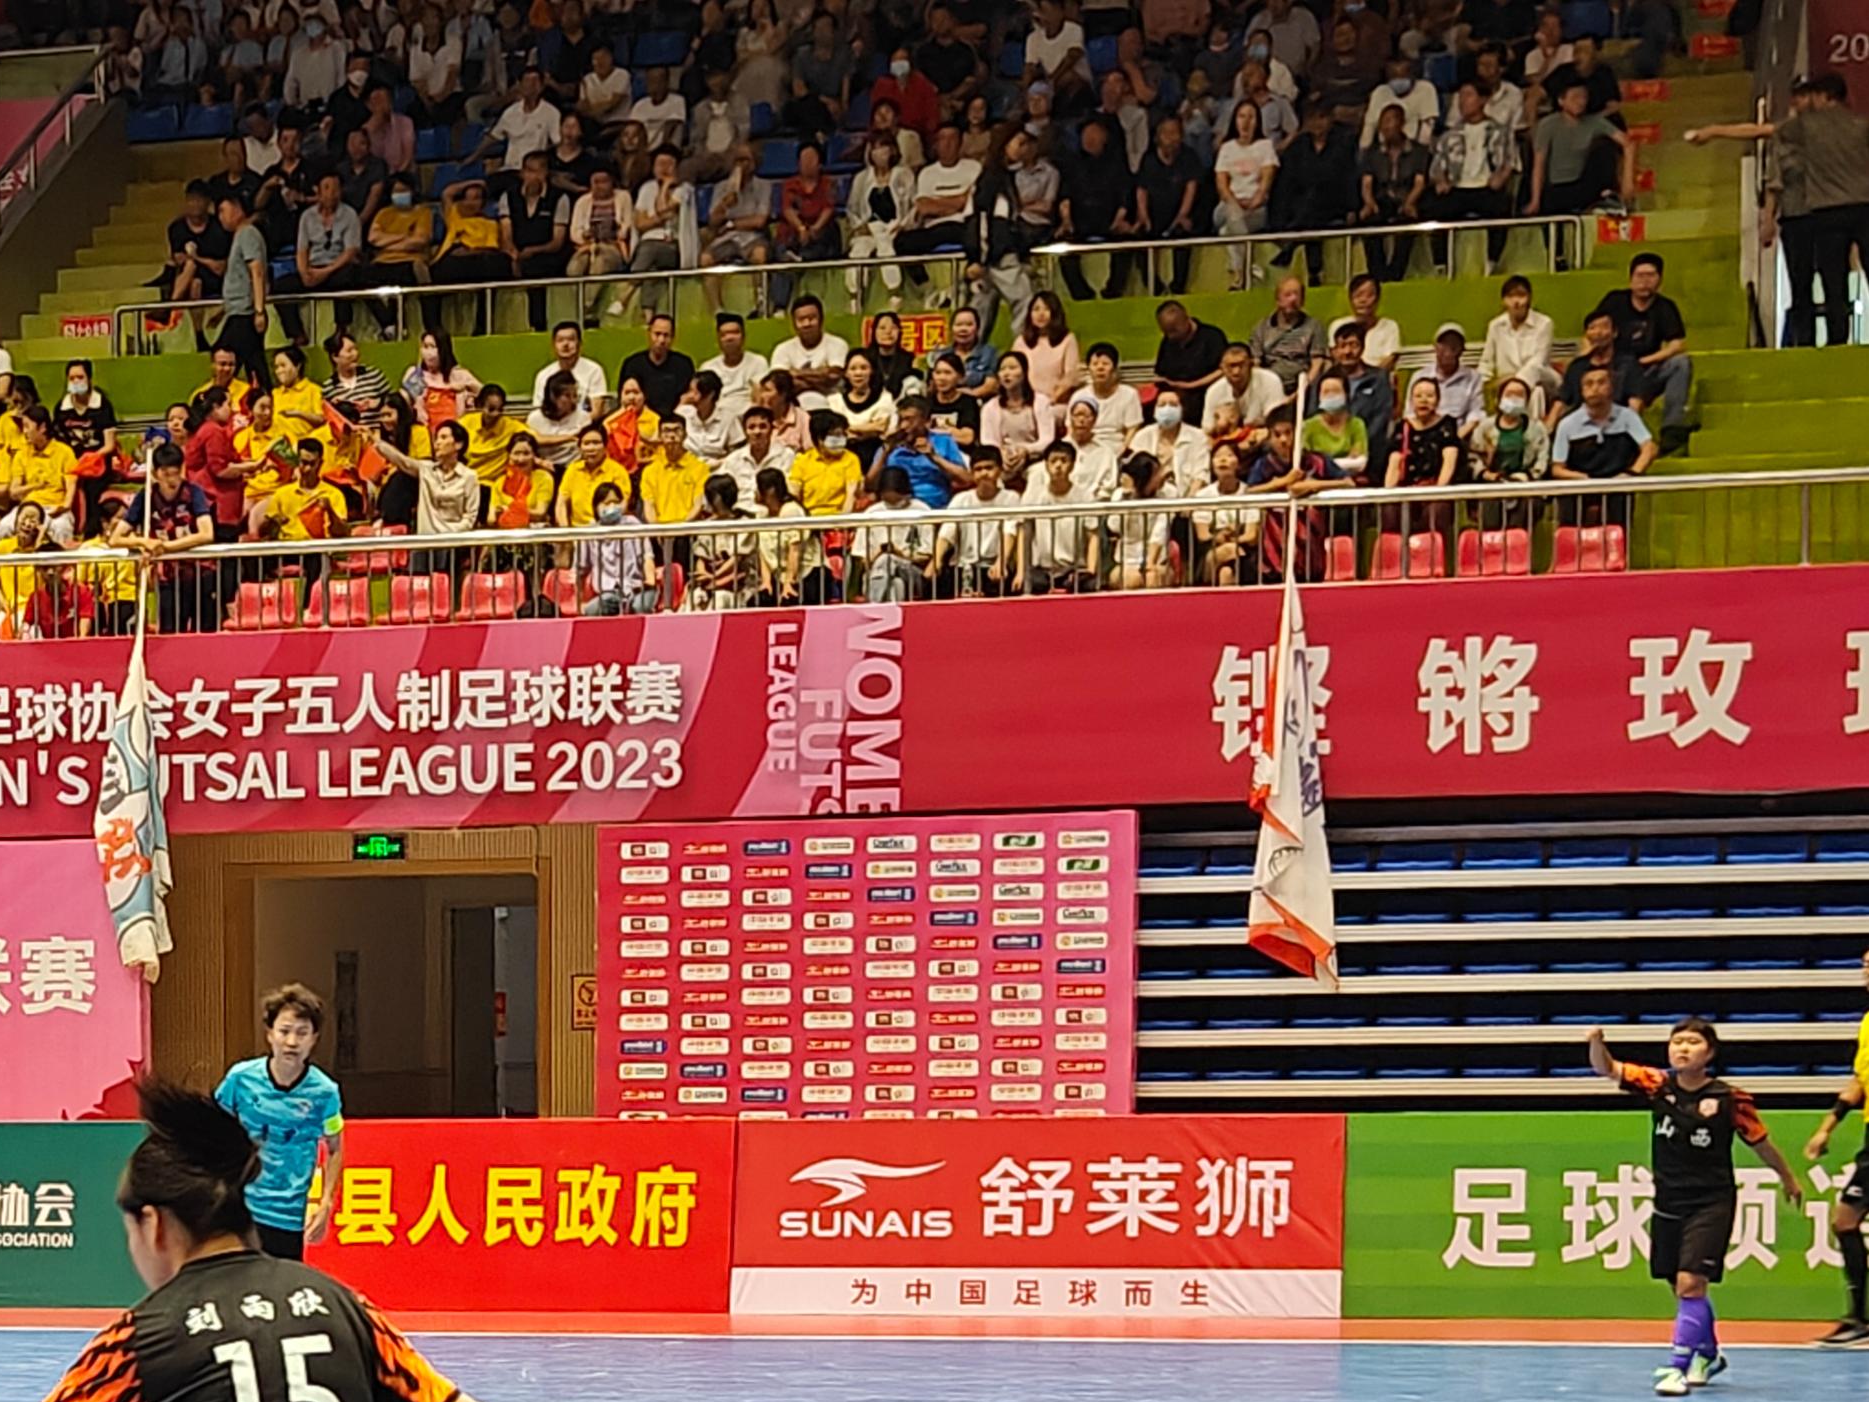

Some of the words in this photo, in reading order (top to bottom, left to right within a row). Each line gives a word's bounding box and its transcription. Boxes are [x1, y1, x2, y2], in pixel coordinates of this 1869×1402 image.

[767, 622, 798, 772] LEAGUE
[317, 744, 536, 798] LEAGUE
[546, 738, 683, 793] 2023
[779, 1210, 953, 1238] SUNAIS
[980, 1156, 1294, 1239] 舒莱狮
[851, 1278, 1210, 1307] 为中国足球而生
